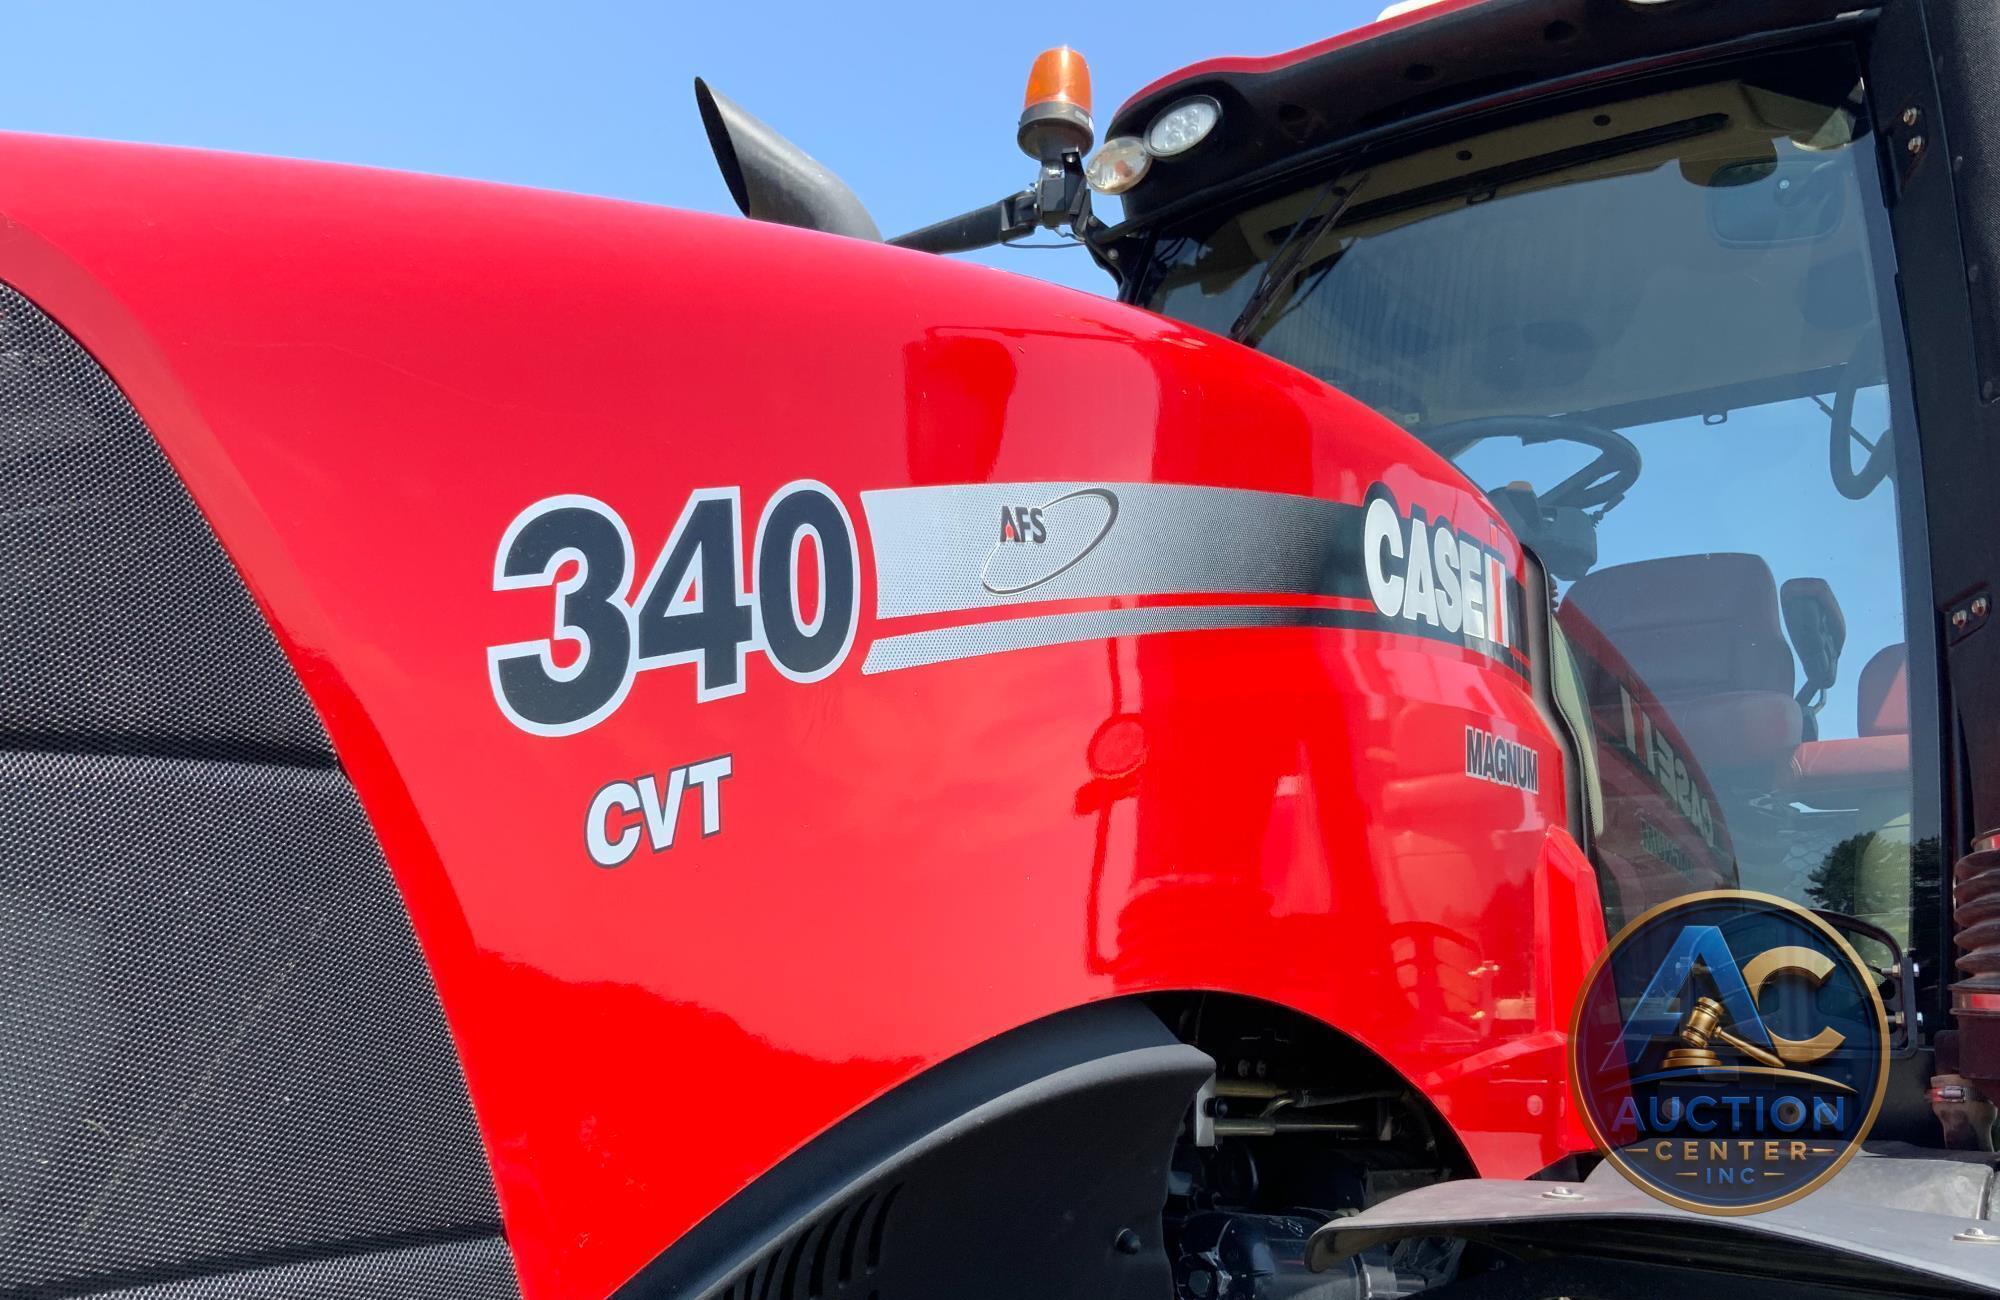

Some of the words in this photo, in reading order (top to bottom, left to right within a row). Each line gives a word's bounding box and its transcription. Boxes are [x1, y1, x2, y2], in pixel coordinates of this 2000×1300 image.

[1000, 505, 1047, 544] AFS
[1364, 498, 1485, 639] CASE
[487, 478, 860, 738] 340
[585, 753, 732, 869] CVT
[1465, 725, 1539, 795] MAGNUM
